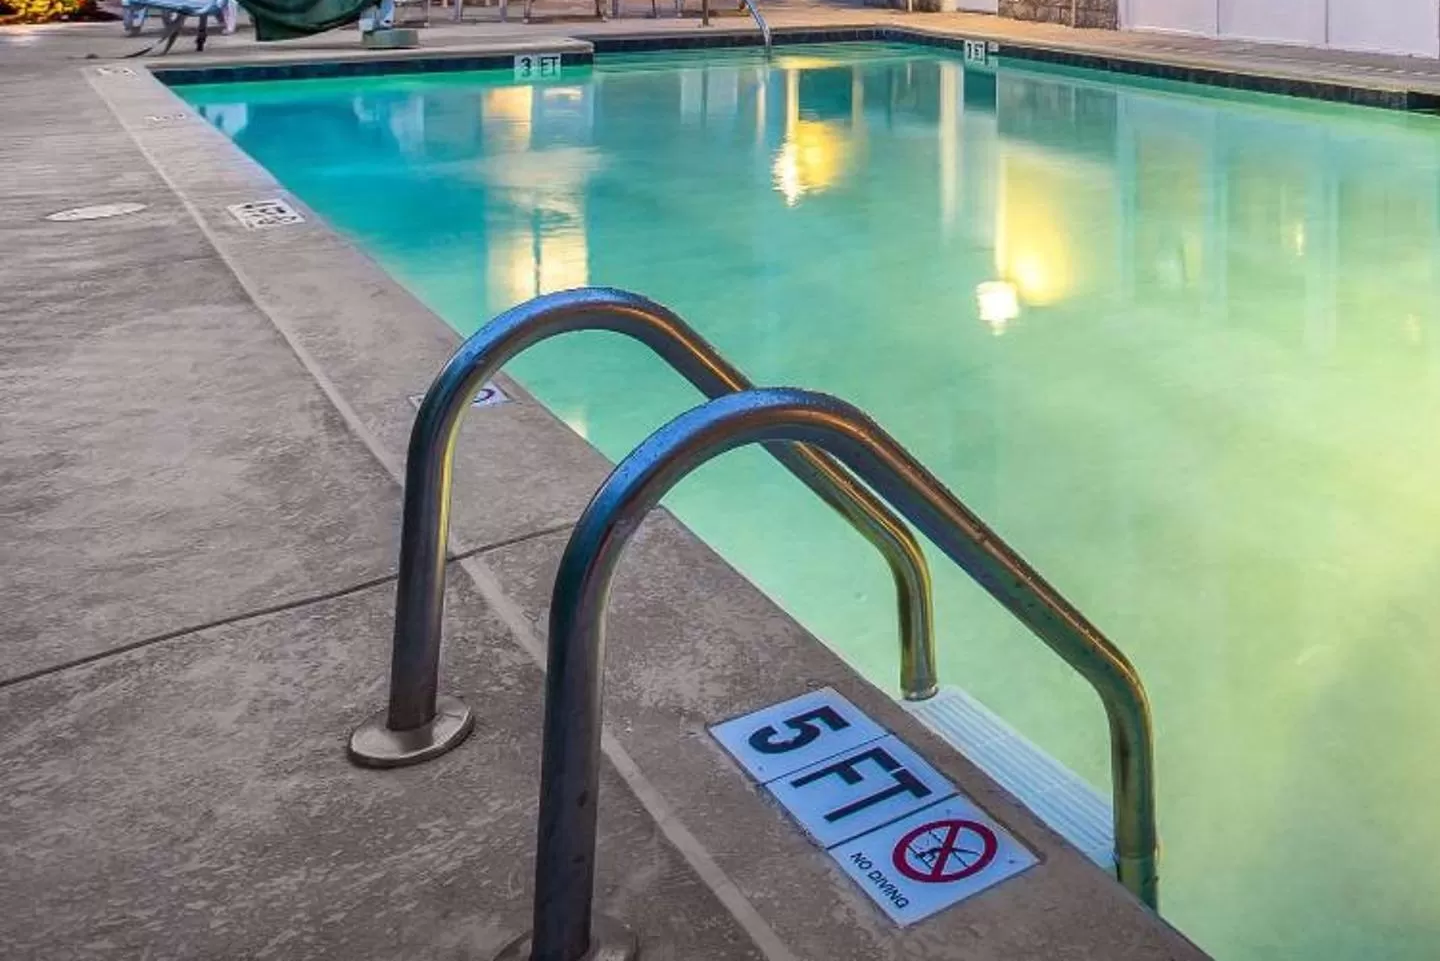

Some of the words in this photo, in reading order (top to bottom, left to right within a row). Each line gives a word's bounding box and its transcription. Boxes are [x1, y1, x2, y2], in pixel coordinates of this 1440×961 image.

[748, 705, 852, 754] 5
[790, 745, 933, 824] FT
[849, 851, 874, 872] NO
[868, 868, 911, 910] DIVING
